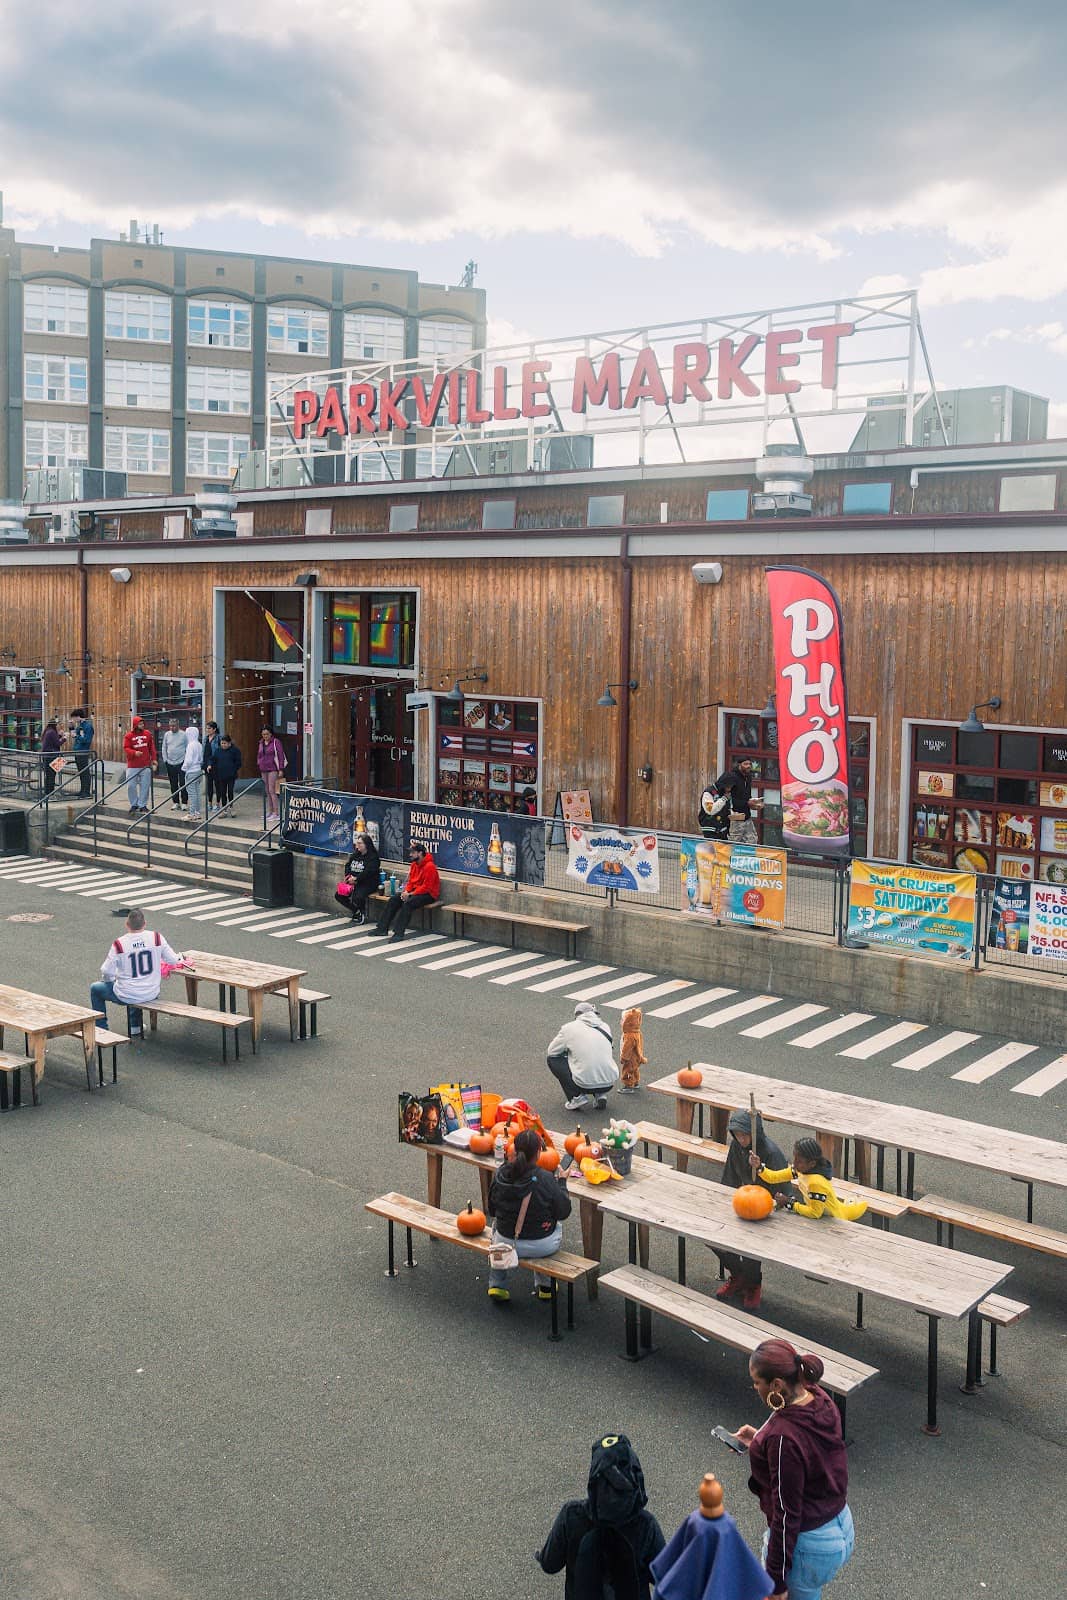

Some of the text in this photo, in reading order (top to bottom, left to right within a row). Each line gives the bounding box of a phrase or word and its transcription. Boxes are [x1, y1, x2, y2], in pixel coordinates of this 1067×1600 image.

[293, 322, 856, 440] PARKVILLE MARKET
[289, 796, 342, 815] REWARD YOUR
[288, 808, 326, 824] FIGHTING
[410, 811, 475, 831] REWARD YOUR
[410, 825, 453, 842] FIGHTING
[725, 873, 783, 890] MONDAYS
[869, 873, 956, 893] SUN CRUISER
[873, 889, 950, 914] SATURDAYS
[1035, 891, 1058, 904] NFL
[857, 906, 876, 929] $3
[896, 936, 915, 945] WIN
[127, 950, 153, 978] 10
